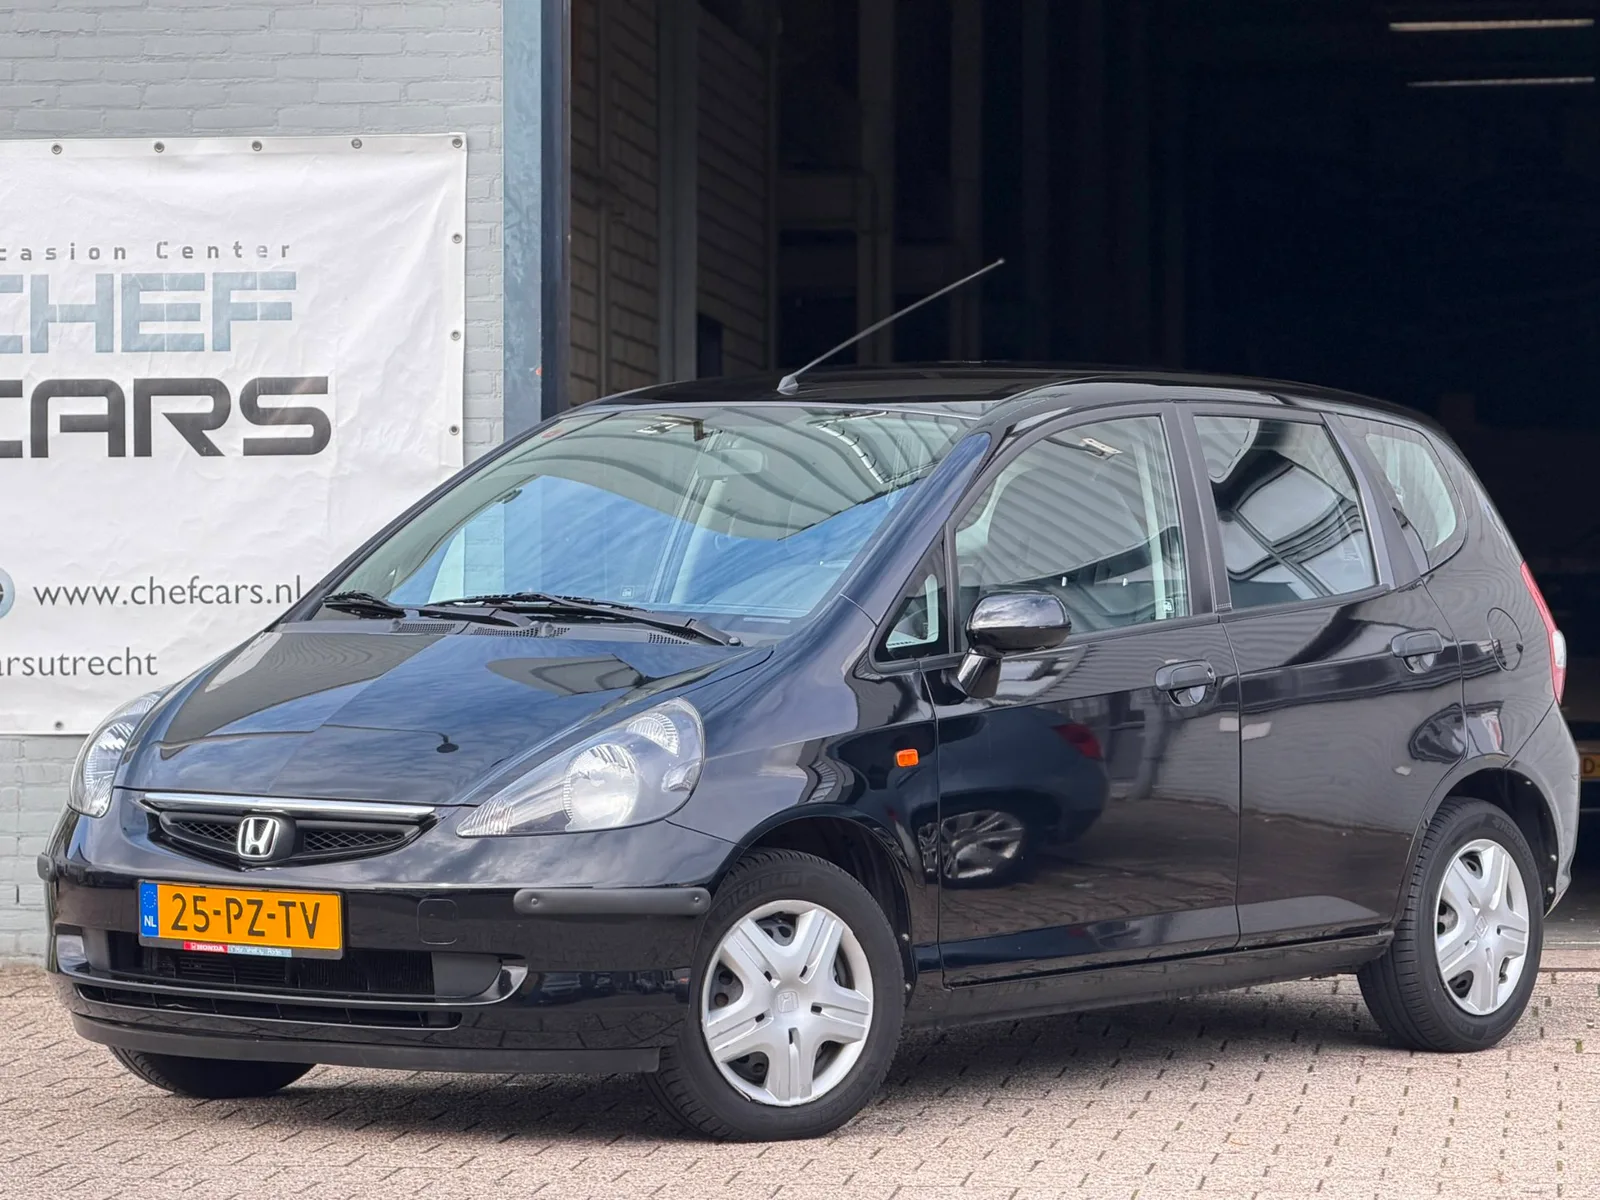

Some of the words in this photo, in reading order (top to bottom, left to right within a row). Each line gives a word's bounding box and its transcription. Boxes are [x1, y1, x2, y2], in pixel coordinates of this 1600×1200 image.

[156, 240, 290, 260] Center
[0, 272, 296, 354] HEF
[0, 376, 331, 458] ARS
[33, 575, 300, 606] www.chefcars.nl
[144, 915, 157, 927] NL
[171, 893, 321, 939] 25-PZ-TV
[197, 944, 225, 953] HONDA
